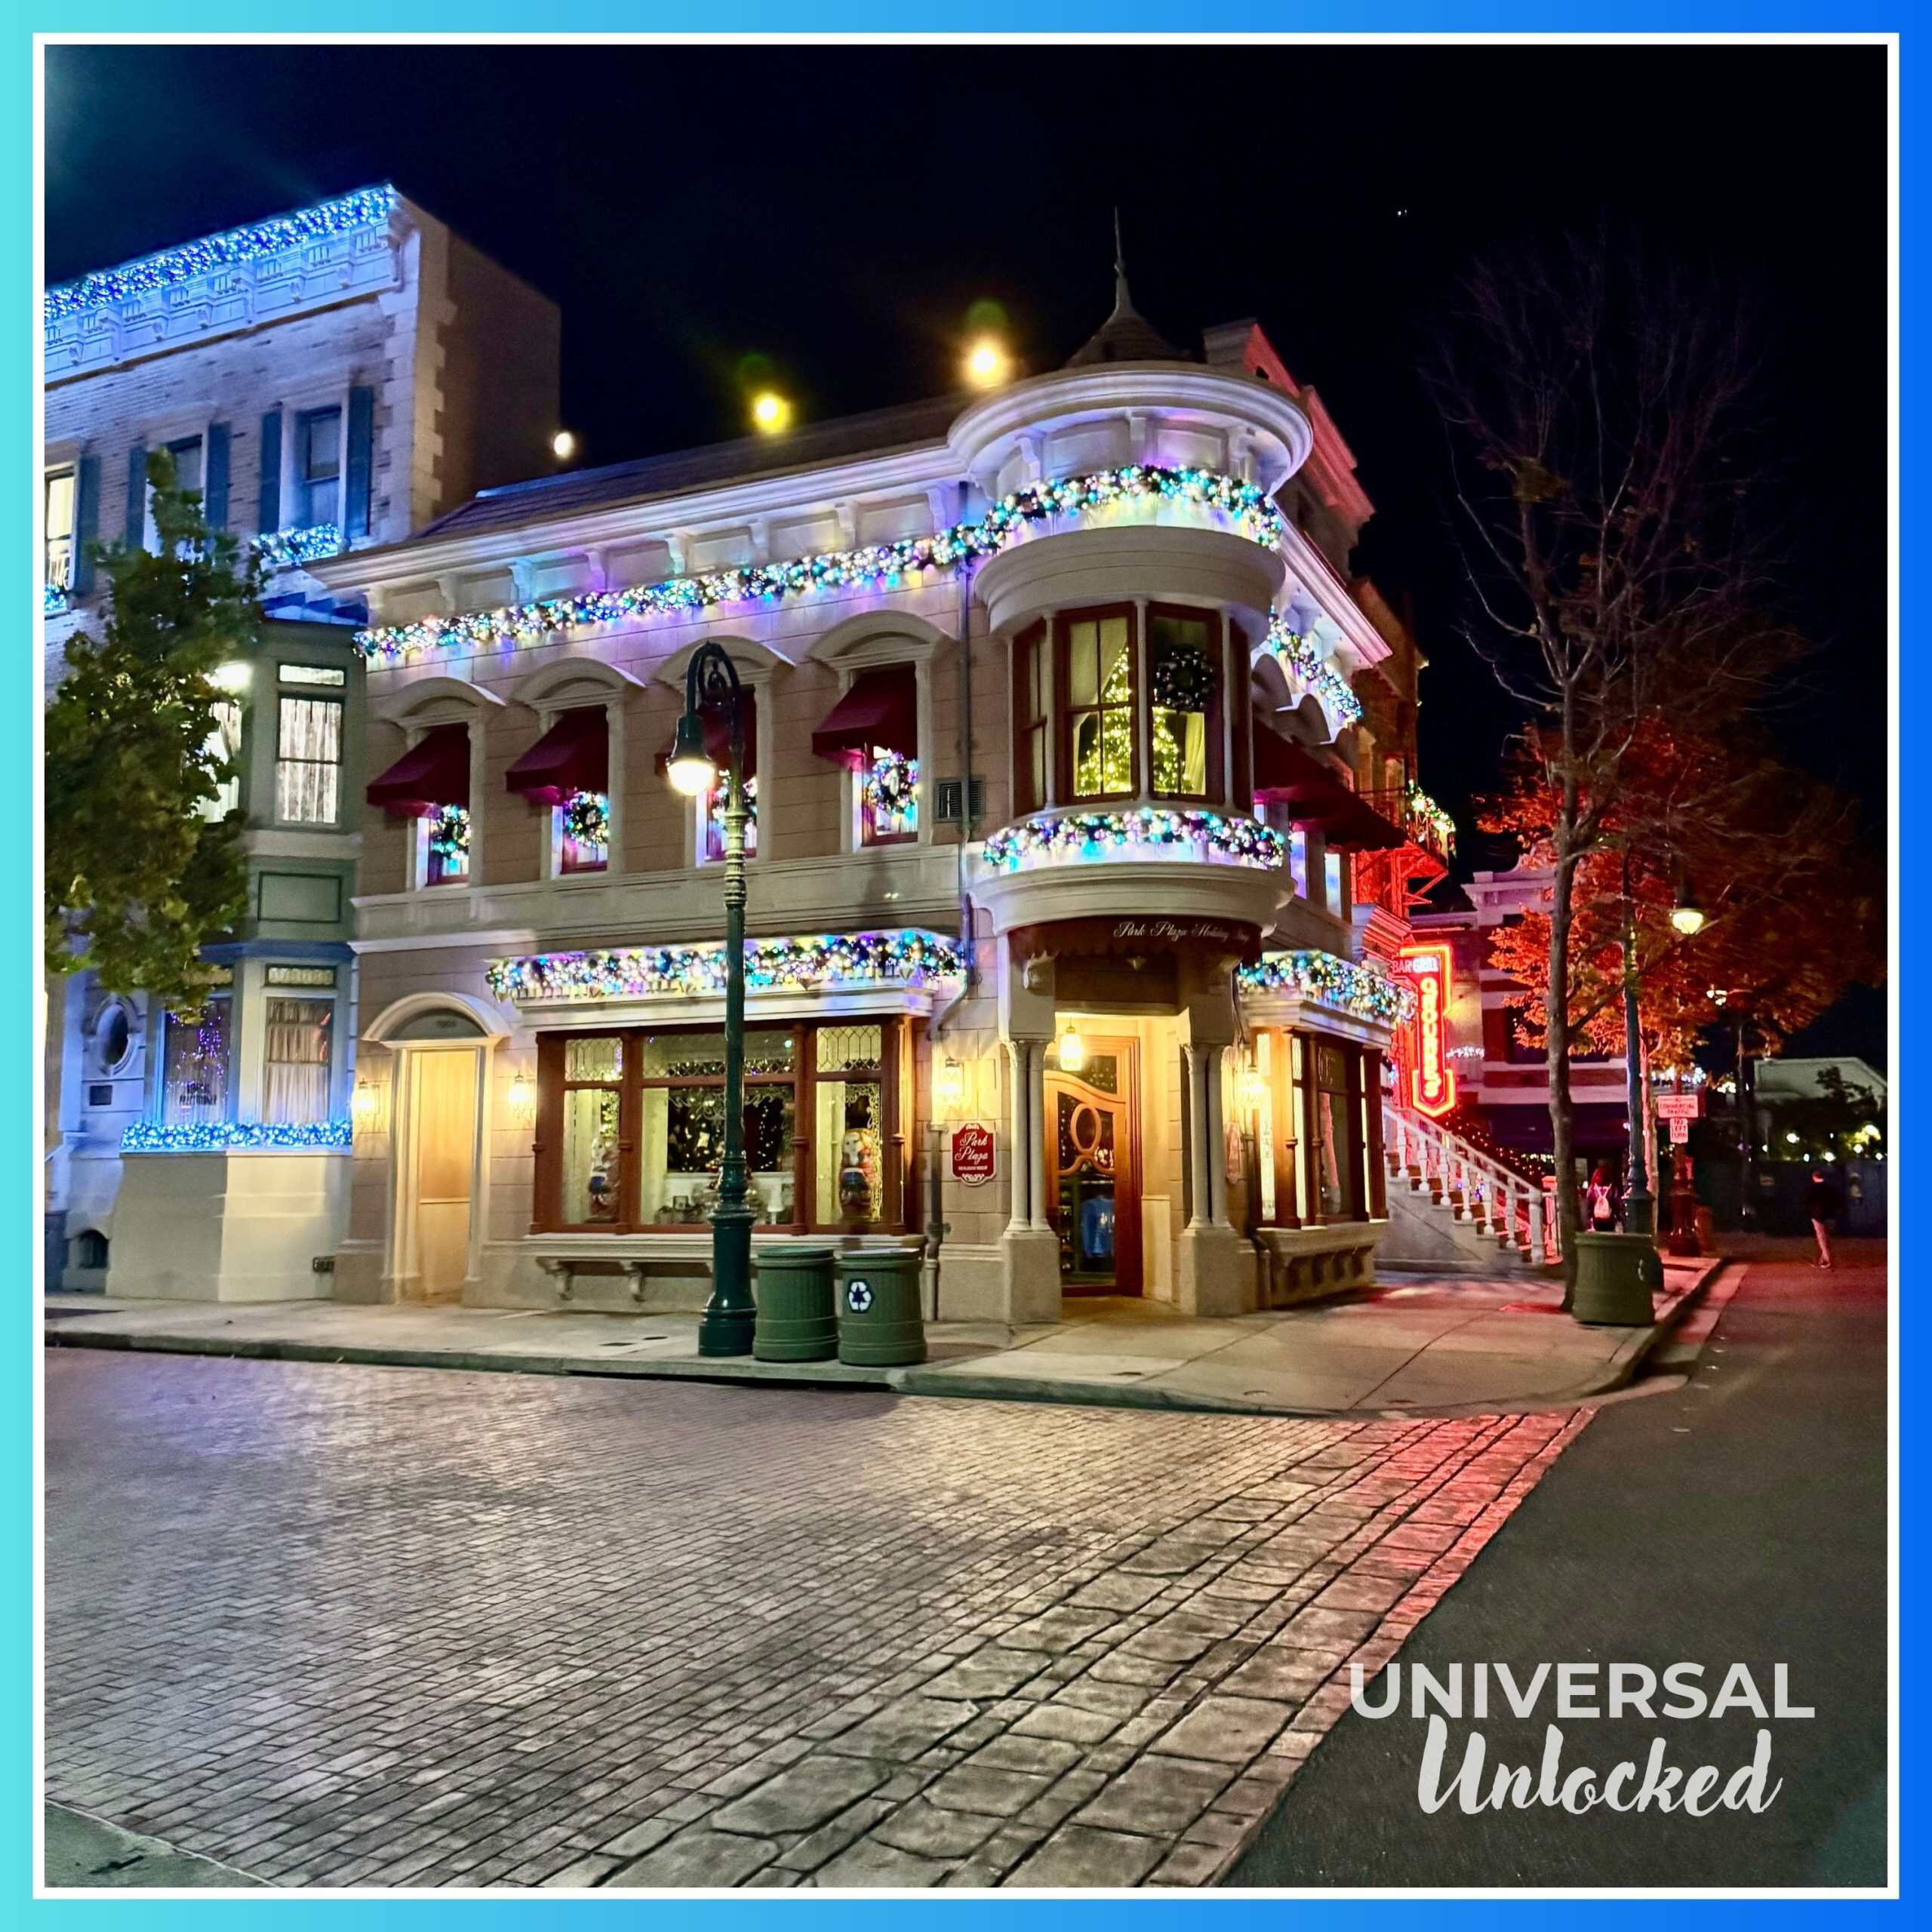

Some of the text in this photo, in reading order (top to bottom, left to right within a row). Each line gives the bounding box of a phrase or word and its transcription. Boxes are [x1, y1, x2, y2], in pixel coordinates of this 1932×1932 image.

[1113, 921, 1145, 937] Park
[1150, 921, 1187, 942] Plaza
[1392, 959, 1411, 974] BAR
[959, 1131, 989, 1146] Park
[954, 1146, 989, 1165] Plaza
